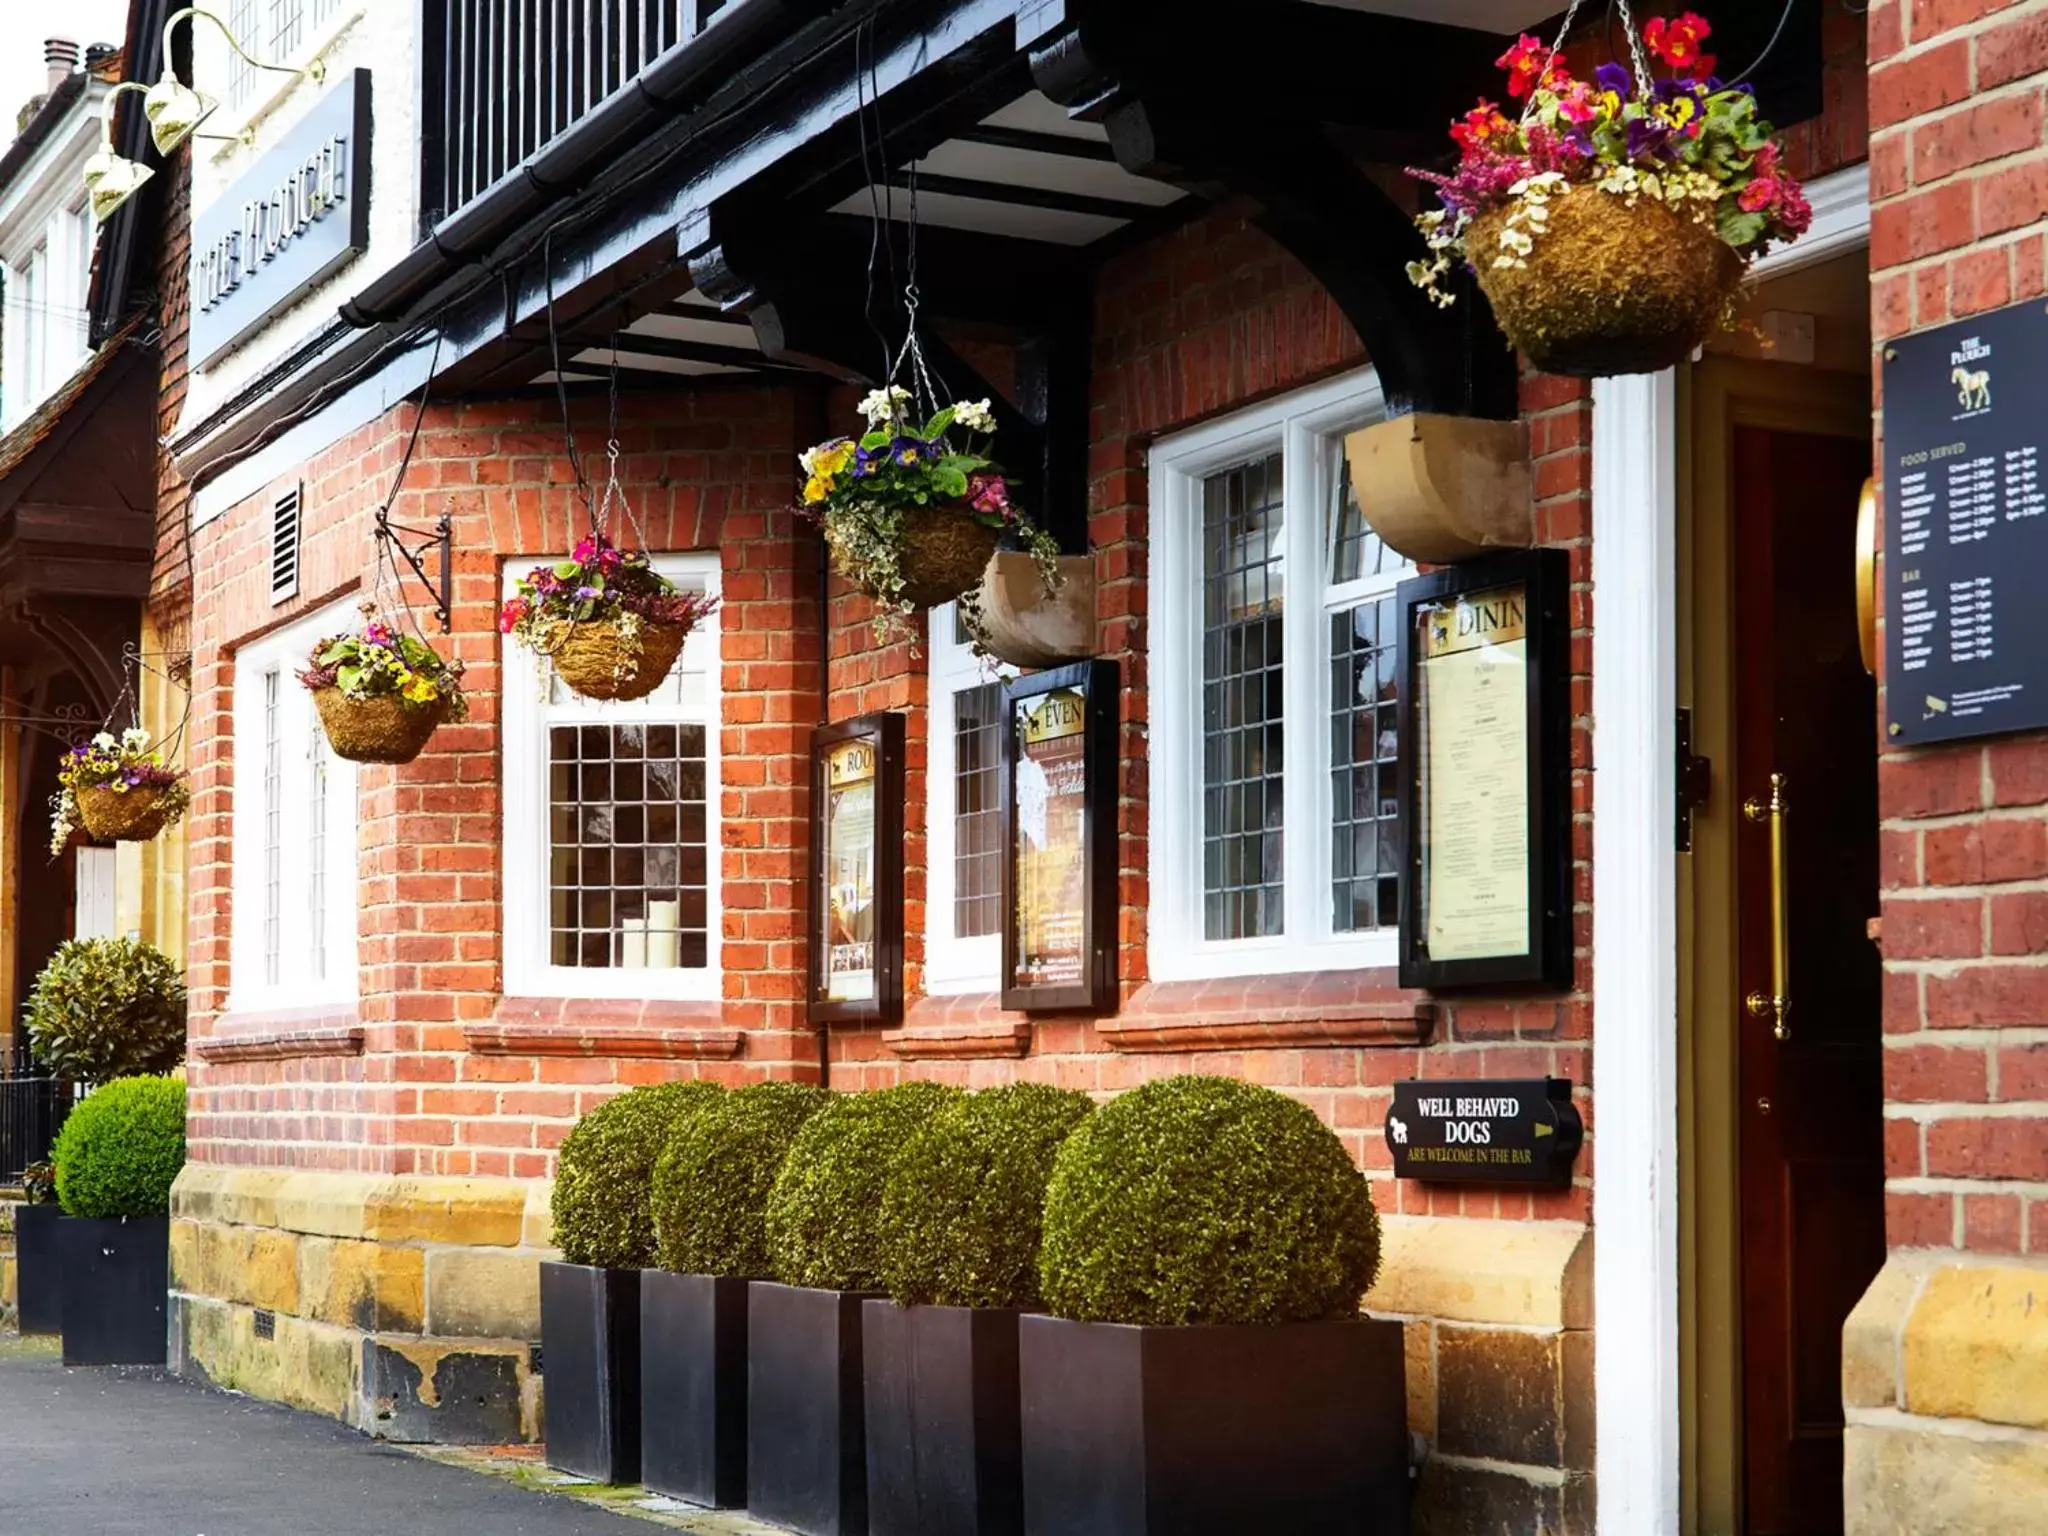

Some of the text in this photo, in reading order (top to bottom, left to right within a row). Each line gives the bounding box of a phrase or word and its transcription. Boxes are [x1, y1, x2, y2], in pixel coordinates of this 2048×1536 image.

[1901, 442, 1966, 467] FOOD SERVED
[1902, 569, 1920, 583] BAR
[1418, 1097, 1520, 1117] WELL BEHAVED
[1445, 1121, 1491, 1144] DOGS
[1408, 1149, 1532, 1164] ARE WELCOME IN THE BAR
